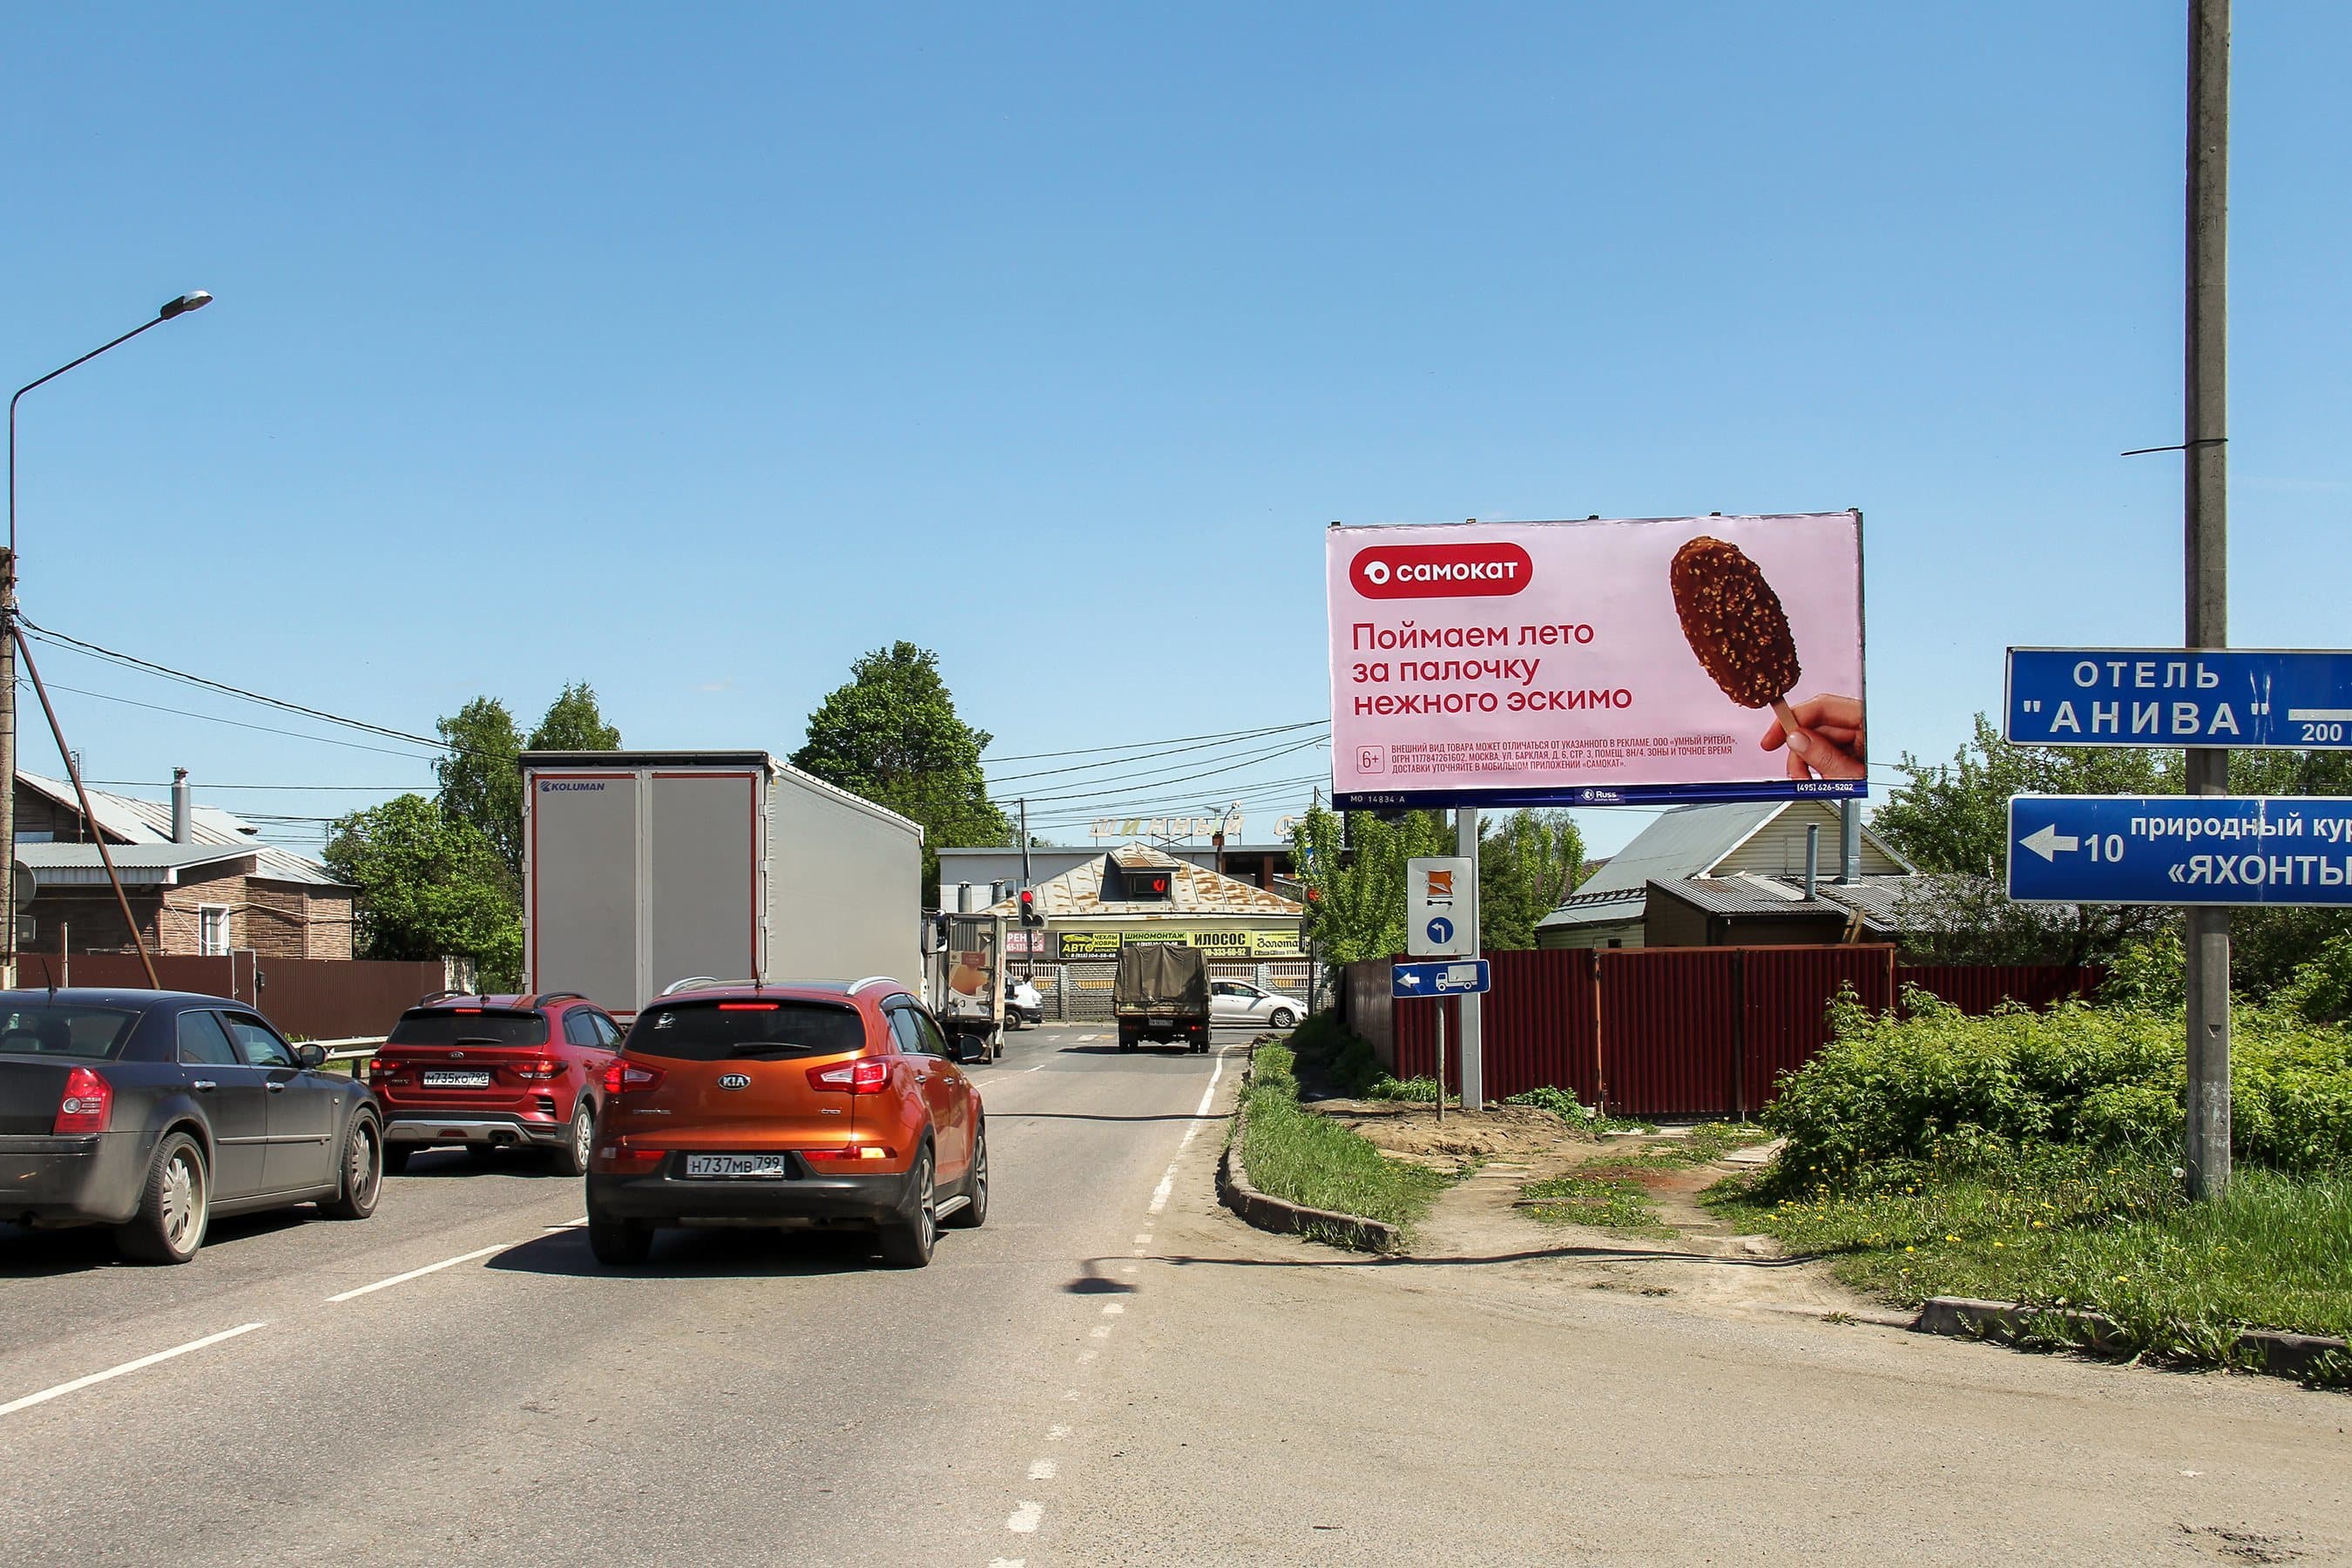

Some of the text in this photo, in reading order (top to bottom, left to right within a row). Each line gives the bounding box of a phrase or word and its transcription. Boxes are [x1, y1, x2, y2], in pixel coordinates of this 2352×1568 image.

[1396, 561, 1518, 583] самокат
[1352, 620, 1595, 651] Поймаем лето
[1352, 659, 1541, 686] за палочку
[2072, 660, 2220, 688] ОТЕЛЬ
[1354, 688, 1633, 715] нежного эскимо
[2023, 700, 2269, 735] "АНИВА"
[2301, 723, 2342, 742] 200
[1391, 742, 1428, 754] ВНЕШНИЙ
[1429, 743, 1445, 754] ВИД
[1447, 743, 1474, 753] ТОВАРА
[1476, 742, 1500, 752] МОЖЕТ
[1502, 740, 1549, 751] ОТЛИЧАТЬСЯ
[1551, 740, 1560, 749] ОТ
[1561, 740, 1608, 750] УКАЗАННОГО
[1610, 739, 1615, 747] В
[1652, 737, 1668, 747] ООО
[1362, 750, 1379, 768] 6+
[1391, 754, 1410, 763] ОГРН
[1502, 752, 1514, 760] УЛ.
[1552, 750, 1559, 760] Д.
[1570, 749, 1585, 759] СТР.
[1595, 748, 1624, 759] ПОМЕЩ.
[1647, 747, 1669, 756] ЗОНЫ
[1678, 747, 1707, 756] ТОЧНОЕ
[1707, 746, 1733, 755] ВРЕМЯ
[1391, 764, 1430, 774] ДОСТАВКИ
[1432, 762, 1474, 774] УТОЧНЯЙТЕ
[1475, 762, 1480, 771] В
[1482, 761, 1529, 771] МОБИЛЬНОМ
[1531, 760, 1581, 770] ПРИЛОЖЕНИИ
[551, 782, 605, 791] KOLUMAN
[1595, 790, 1618, 799] Russ
[1796, 783, 1816, 792] (495)
[1368, 794, 1395, 803] 14834
[1088, 812, 1246, 837] ШИННЫЙ
[2130, 811, 2302, 841] природный
[2084, 834, 2125, 862] 10
[1062, 943, 1095, 952] АВТО
[1194, 933, 1246, 946] ИЛОСОС
[1257, 937, 1310, 948] Золотаь
[722, 1076, 747, 1087] KIA
